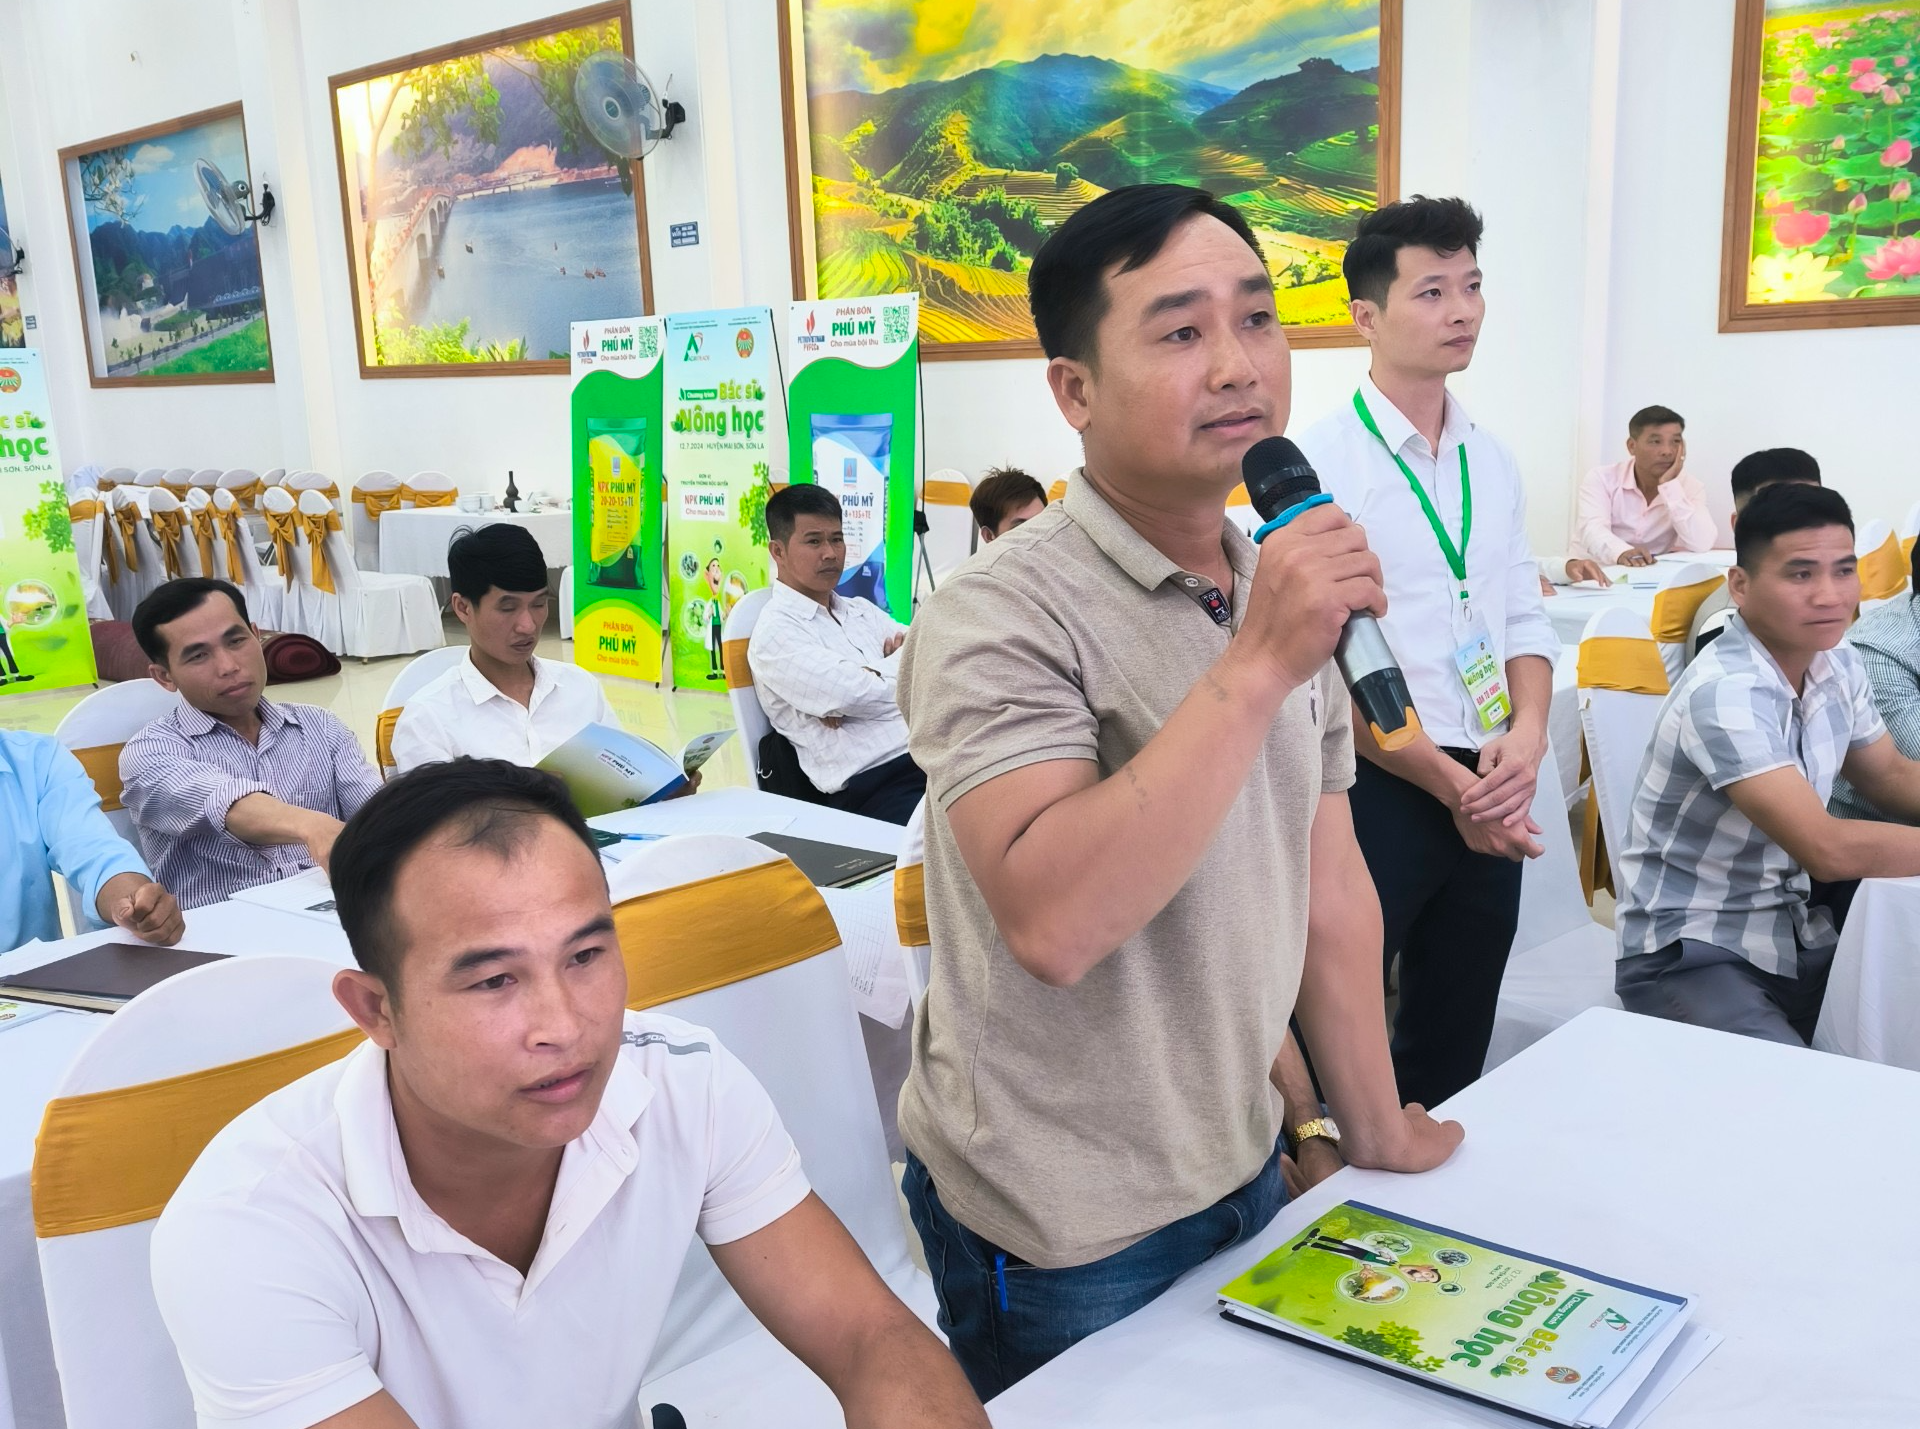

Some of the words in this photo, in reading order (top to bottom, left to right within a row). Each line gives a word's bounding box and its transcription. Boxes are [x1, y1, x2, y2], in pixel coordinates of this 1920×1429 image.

[836, 306, 855, 315] PHÂN
[857, 305, 871, 314] BÓN
[604, 326, 619, 334] PHÂN
[832, 317, 855, 336] PHÚ
[858, 316, 876, 335] MỸ
[601, 335, 619, 351] PHÚ
[620, 334, 634, 350] MỸ
[857, 338, 867, 347] bội
[719, 379, 742, 400] Bác
[745, 379, 758, 399] sĩ
[14, 410, 32, 429] sĩ
[679, 404, 727, 437] Nông
[731, 404, 764, 438] học
[0, 433, 49, 462] học
[679, 442, 704, 450] 12.7.2024
[706, 441, 724, 451] HUYỆN
[745, 441, 757, 449] SƠN
[757, 442, 765, 450] LA
[24, 464, 41, 472] SƠN
[597, 480, 610, 493] NPK
[610, 478, 625, 493] PHÚ
[626, 478, 636, 494] MỸ
[684, 494, 698, 505] NPK
[699, 492, 714, 506] PHÚ
[714, 492, 725, 506] MỸ
[842, 491, 860, 507] PHÚ
[861, 492, 874, 507] MỸ
[685, 507, 697, 515] Cho
[603, 621, 620, 631] PHÂN
[620, 622, 634, 632] BÓN
[599, 633, 619, 652] PHÚ
[621, 635, 637, 655] MỸ
[596, 653, 607, 663] Cho
[608, 656, 620, 664] mùa
[630, 658, 639, 667] thu
[1487, 1280, 1567, 1329] Nông
[1450, 1327, 1517, 1368] học
[1515, 1328, 1559, 1358] Bác
[1500, 1355, 1529, 1375] sĩ
